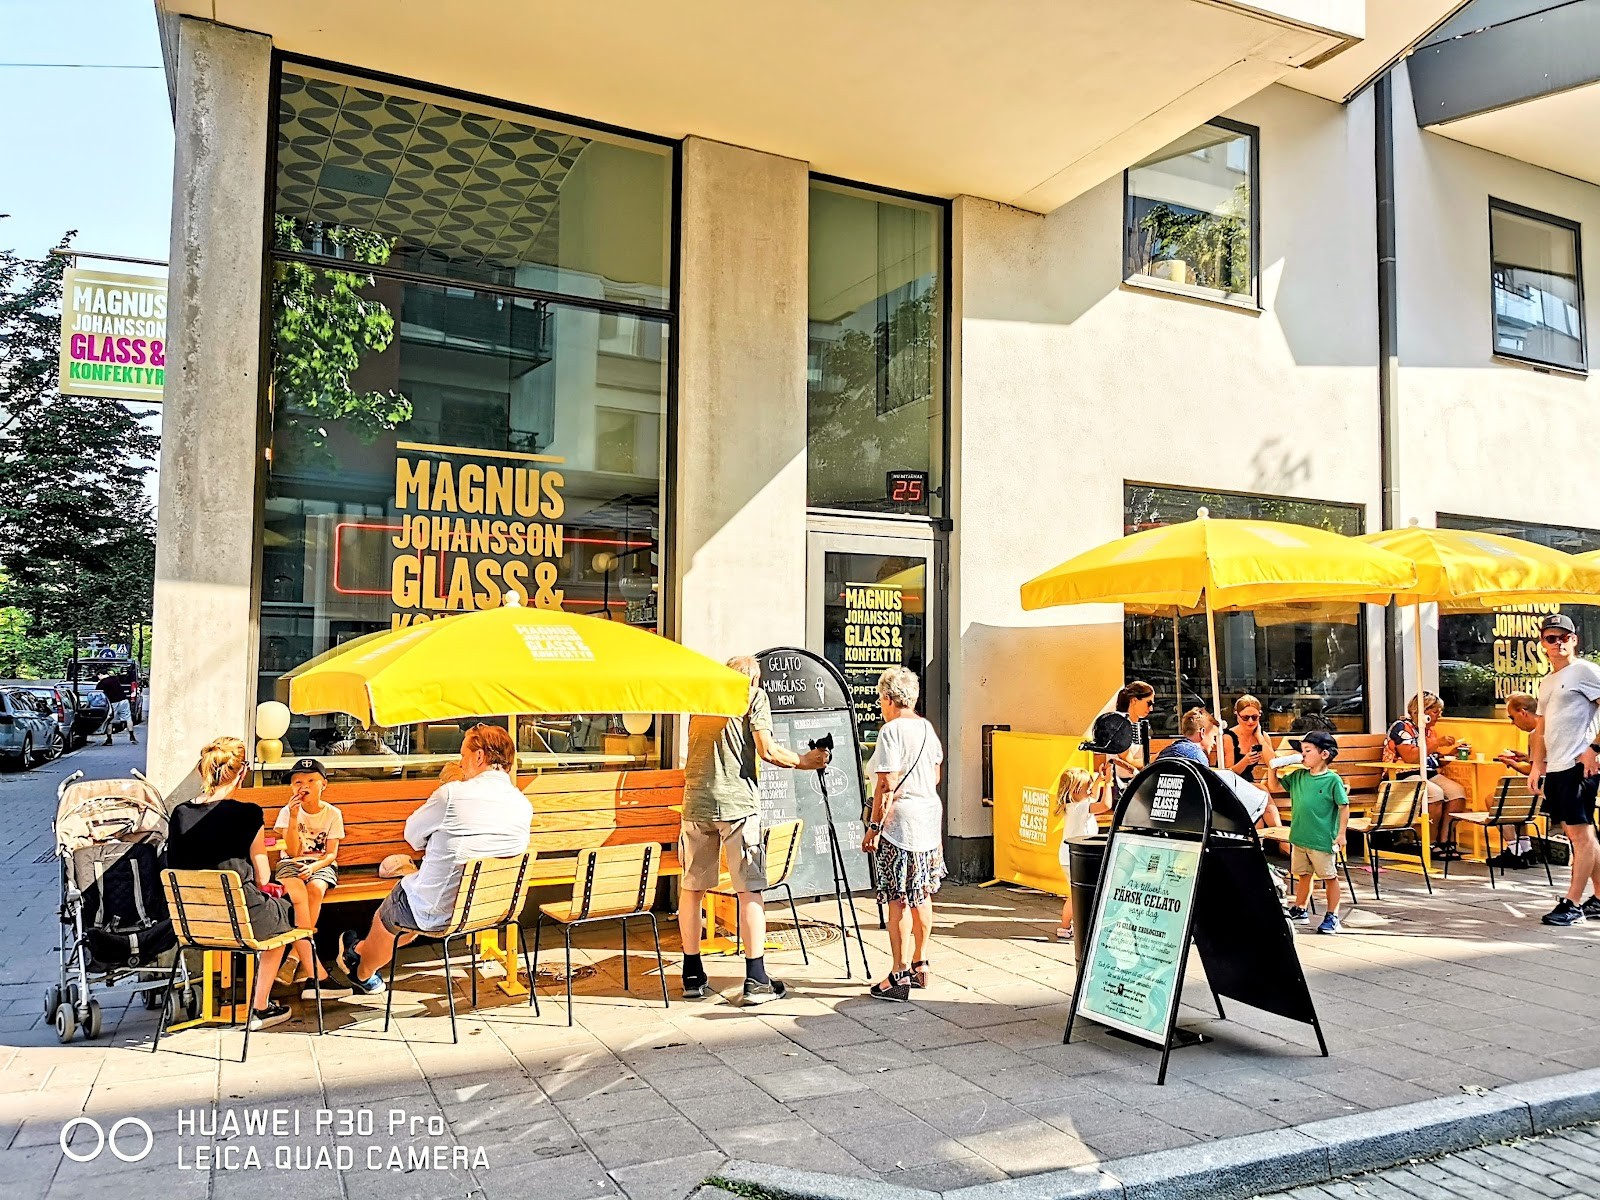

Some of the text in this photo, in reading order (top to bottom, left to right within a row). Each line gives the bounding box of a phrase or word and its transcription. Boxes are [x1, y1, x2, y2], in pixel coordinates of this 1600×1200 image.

[73, 286, 167, 319] MAGNUS
[71, 314, 166, 338] JOHANSSON
[71, 334, 165, 366] GLASS &
[69, 361, 165, 385] KONFEKTYR
[395, 457, 565, 519] MAGNUS
[893, 480, 921, 500] 25
[392, 514, 564, 558] JOHANSSON
[391, 554, 564, 612] GLASS &
[845, 588, 902, 610] MAGNUS
[845, 609, 902, 625] JOHANSSON
[845, 625, 903, 647] GLASS &
[769, 656, 802, 672] GELATO
[845, 647, 902, 662] KONFEKTYR
[1493, 639, 1549, 675] GLASS
[777, 694, 796, 706] MENY
[1157, 776, 1184, 790] MAGNUS
[1022, 789, 1050, 807] MAGNUS
[1153, 797, 1174, 809] GLASS
[1020, 813, 1043, 831] GLASS
[1113, 886, 1181, 913] FÄRSK GELATO
[1146, 908, 1159, 924] dag
